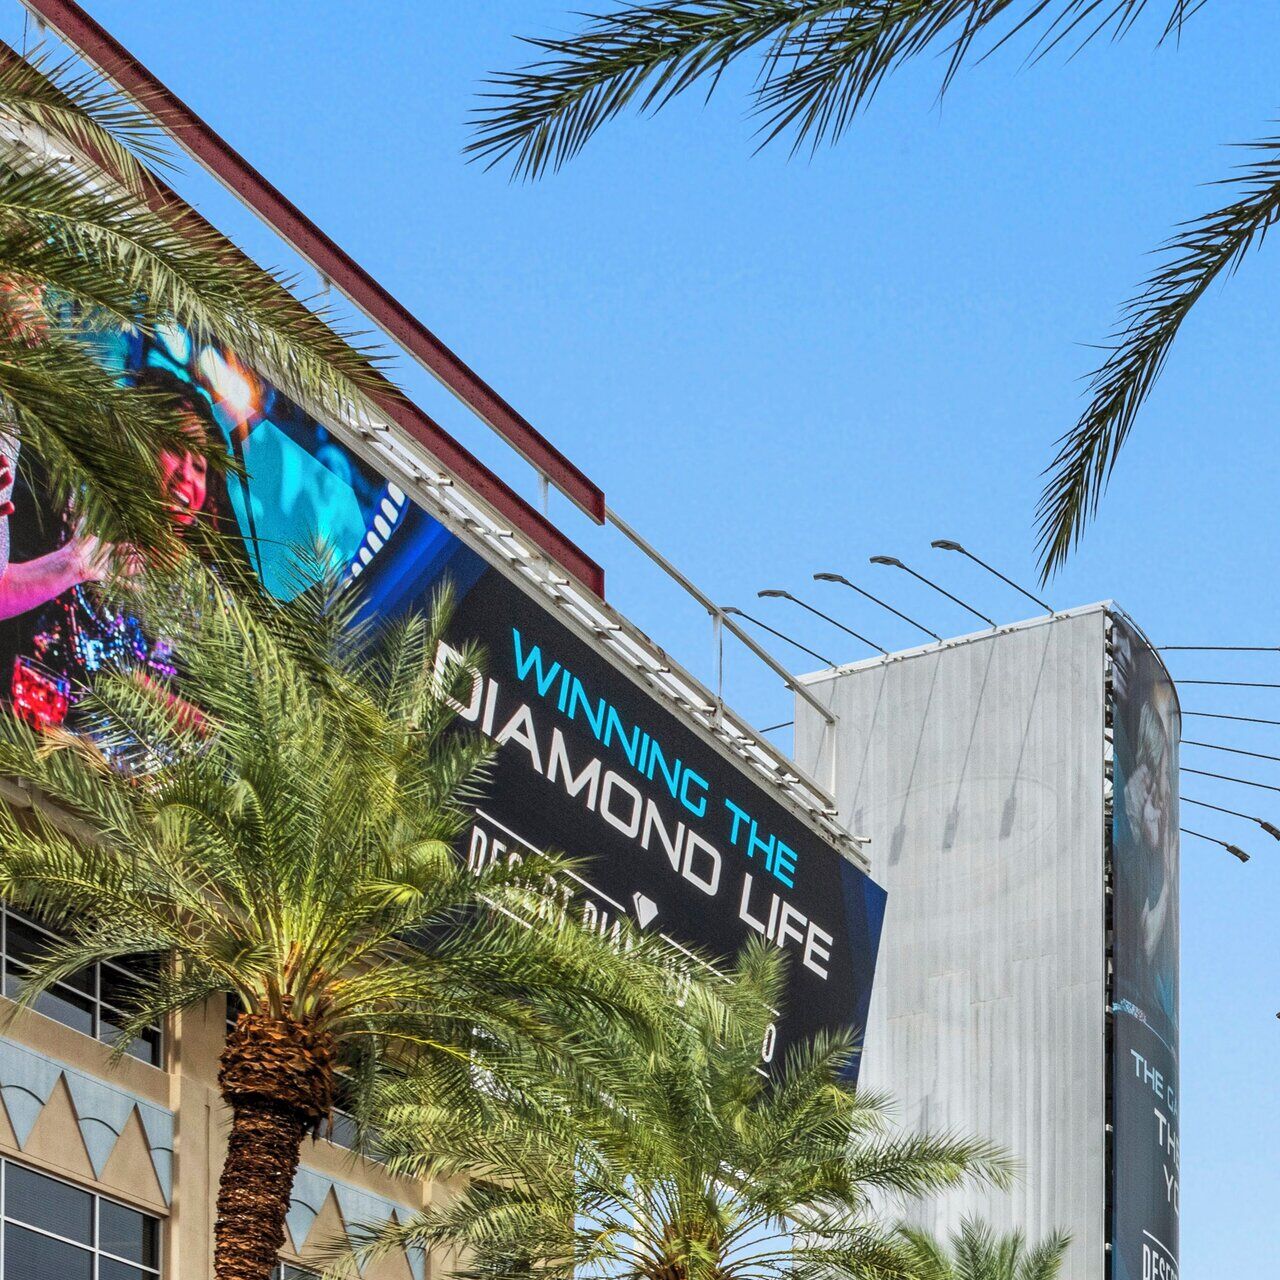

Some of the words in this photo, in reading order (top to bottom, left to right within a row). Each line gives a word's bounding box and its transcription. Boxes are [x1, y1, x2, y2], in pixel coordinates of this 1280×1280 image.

[431, 639, 723, 897] DIAMOND
[738, 873, 834, 981] LIFE
[511, 627, 710, 819] WINNING
[725, 797, 799, 889] THE
[1130, 1049, 1164, 1100] THE
